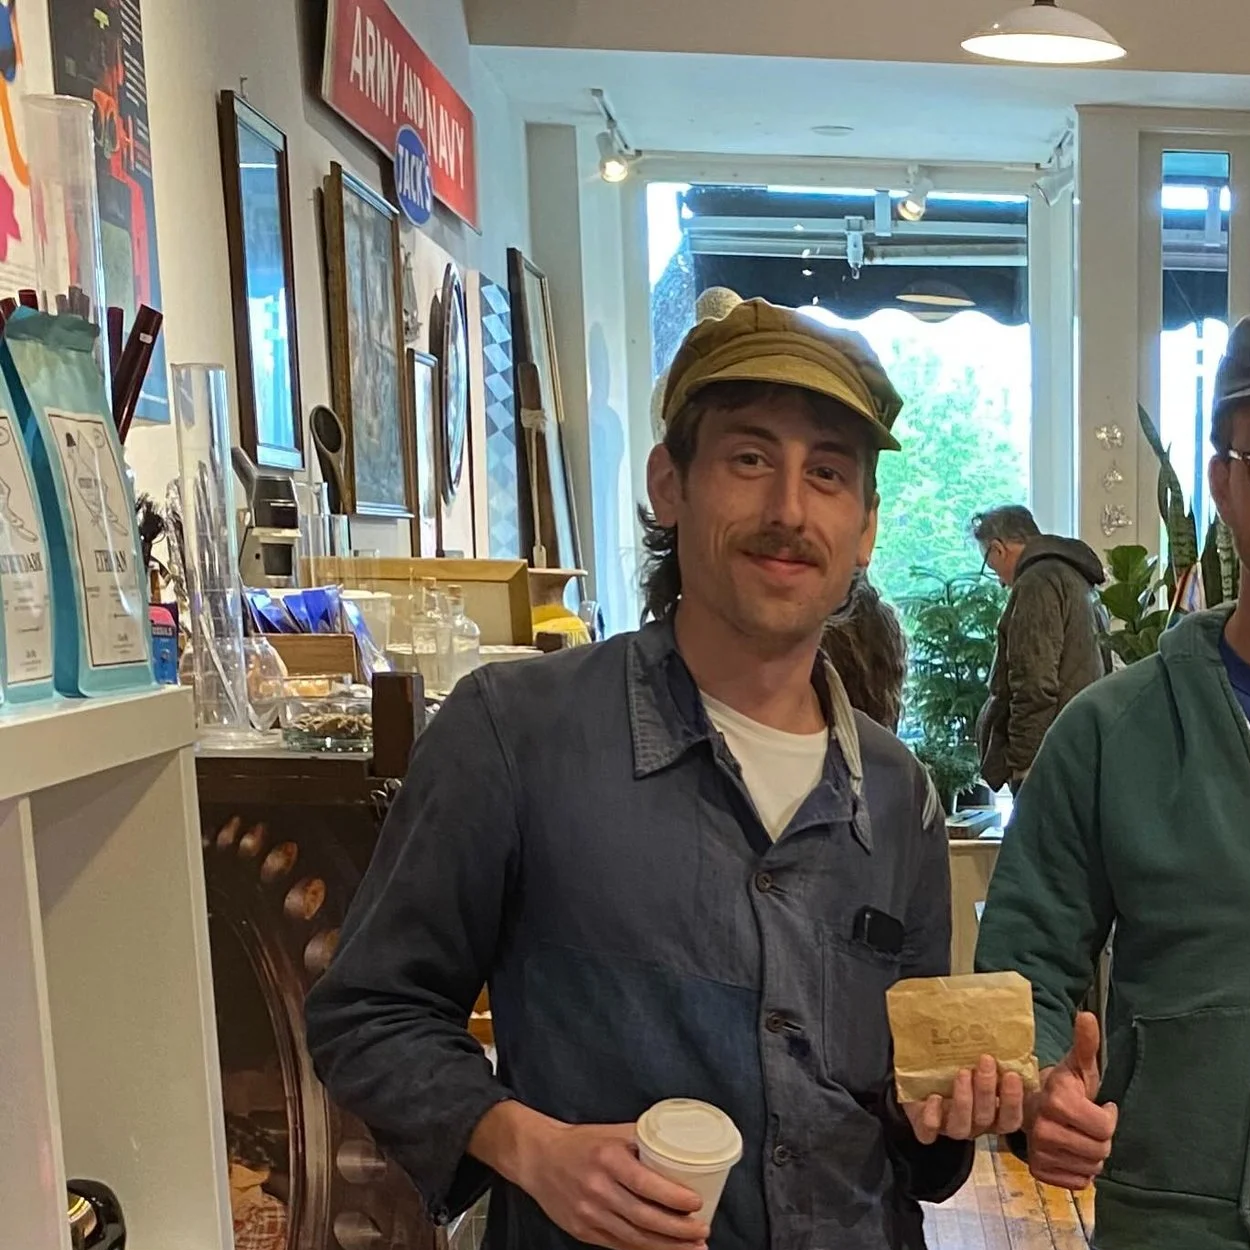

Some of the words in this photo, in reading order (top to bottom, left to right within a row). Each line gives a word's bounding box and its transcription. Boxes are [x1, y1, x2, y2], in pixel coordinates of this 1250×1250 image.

[350, 6, 400, 125] ARMY
[402, 62, 425, 130] AND
[425, 87, 465, 190] NAVY
[398, 143, 432, 212] JACK'S
